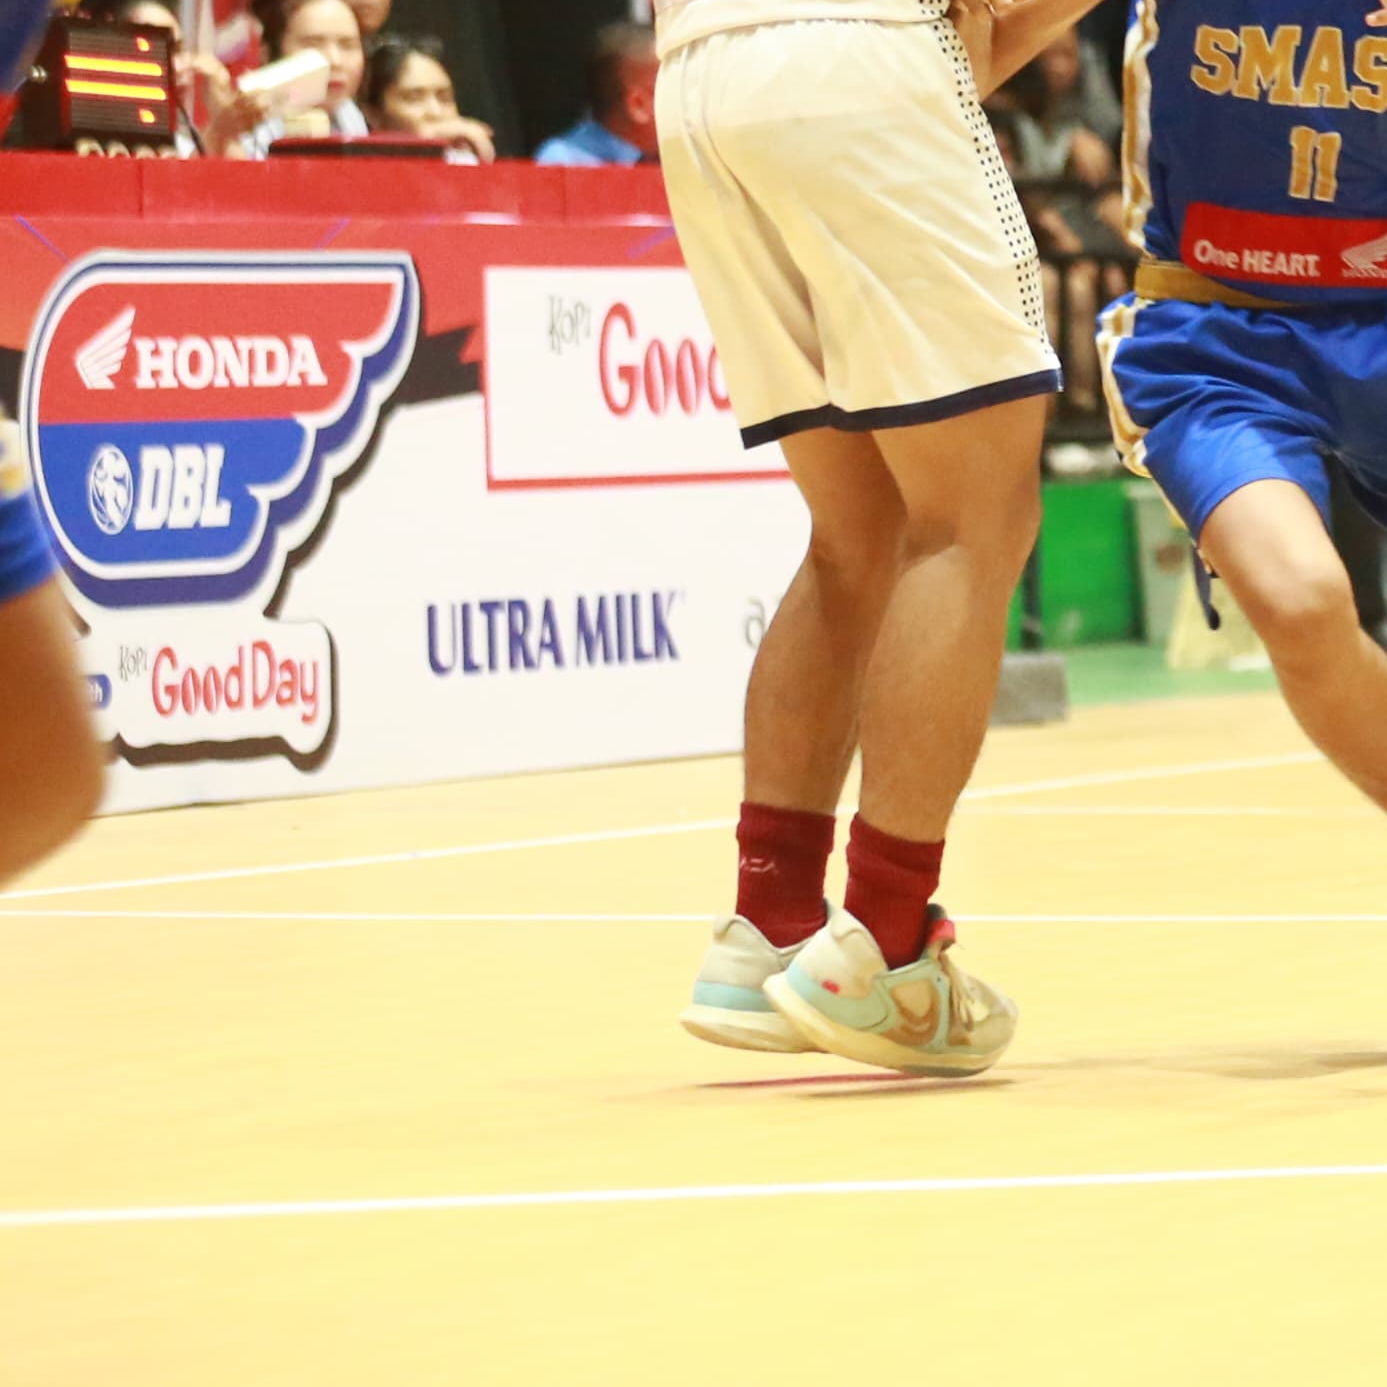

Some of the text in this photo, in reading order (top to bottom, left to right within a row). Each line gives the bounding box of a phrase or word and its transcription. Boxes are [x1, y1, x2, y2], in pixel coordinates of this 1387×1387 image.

[1289, 125, 1342, 203] 11
[1193, 239, 1240, 269] One
[134, 334, 329, 390] HONDA
[134, 442, 232, 531] DBL
[427, 596, 566, 678] ULTRA
[575, 589, 680, 670] MILK
[151, 646, 247, 718] Good
[252, 640, 320, 725] Day
